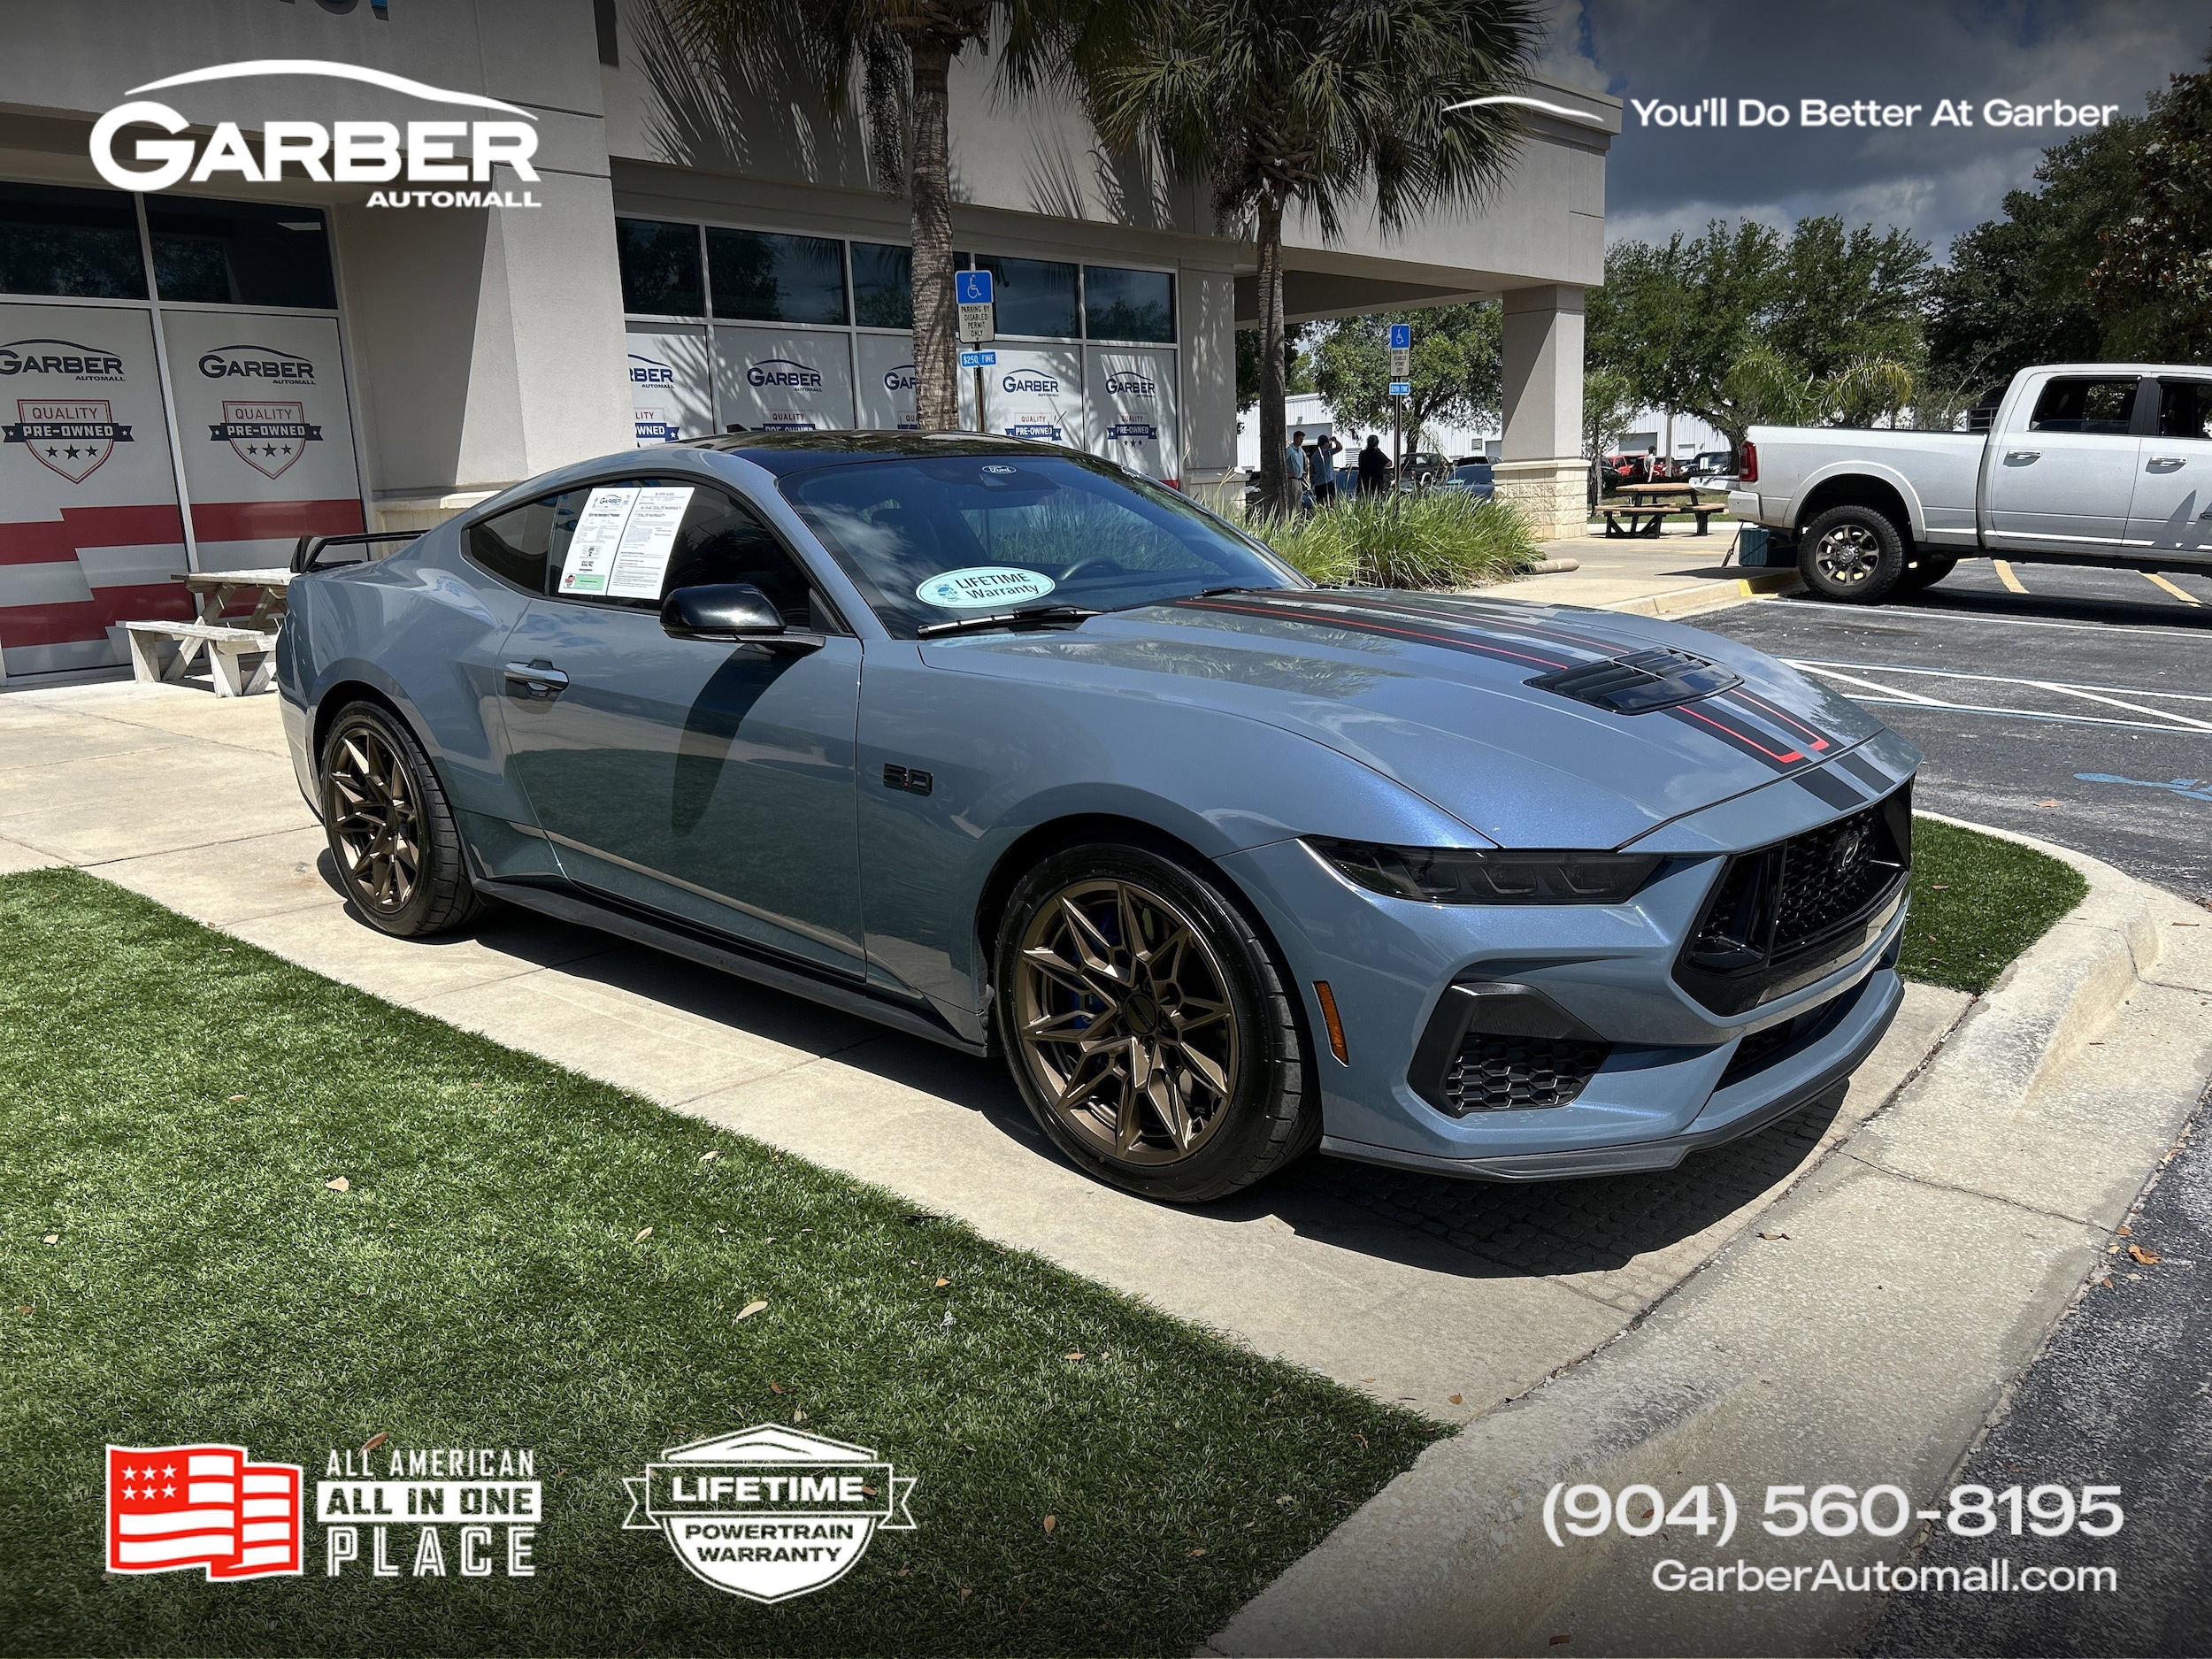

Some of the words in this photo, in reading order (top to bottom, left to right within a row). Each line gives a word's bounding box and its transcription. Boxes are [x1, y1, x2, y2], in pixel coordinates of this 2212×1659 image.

[0, 349, 124, 375] GARBER
[199, 354, 315, 379] GARBER
[963, 355, 979, 365] $250
[981, 354, 995, 364] FINE
[629, 368, 673, 382] BER
[747, 367, 821, 387] GARBER
[1002, 376, 1059, 393] GARBER
[1105, 379, 1155, 394] GARBER
[32, 407, 97, 420] QUALITY
[235, 408, 292, 420] QUALITY
[22, 426, 114, 437] PRE-OWNED
[227, 425, 305, 436] PRE-OWNED
[956, 573, 1030, 588] LIFETIME
[965, 585, 1039, 599] Warranty
